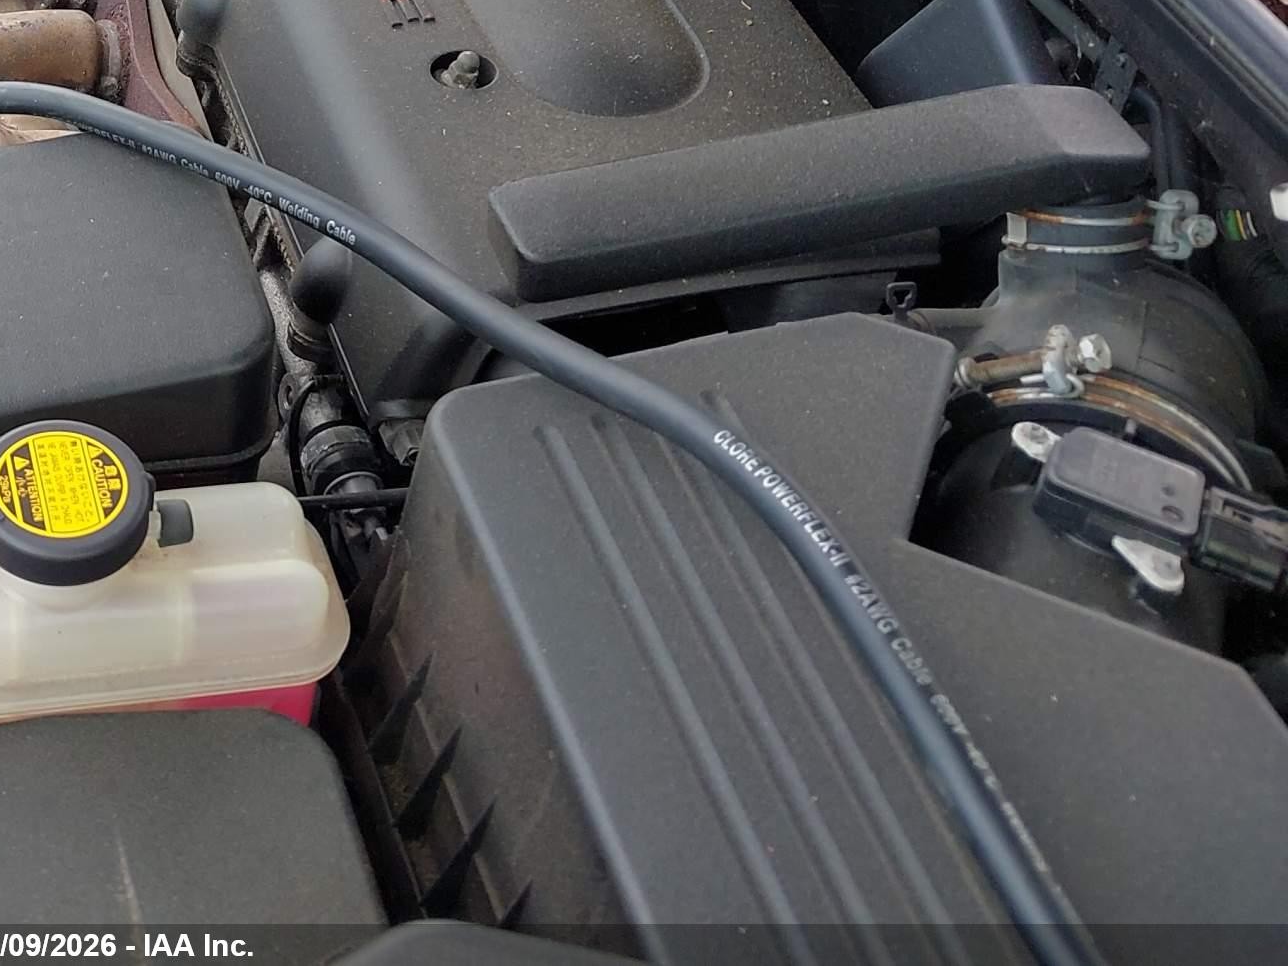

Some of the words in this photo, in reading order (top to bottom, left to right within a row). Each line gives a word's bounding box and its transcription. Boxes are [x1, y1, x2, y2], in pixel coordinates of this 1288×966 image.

[279, 197, 321, 229] Welding
[326, 220, 357, 246] Cable
[23, 468, 44, 522] ATTENTION
[91, 458, 114, 508] CAUTION
[713, 430, 759, 472] CLORE
[753, 465, 851, 567] POWERFLEX-II
[891, 637, 933, 686] Cable
